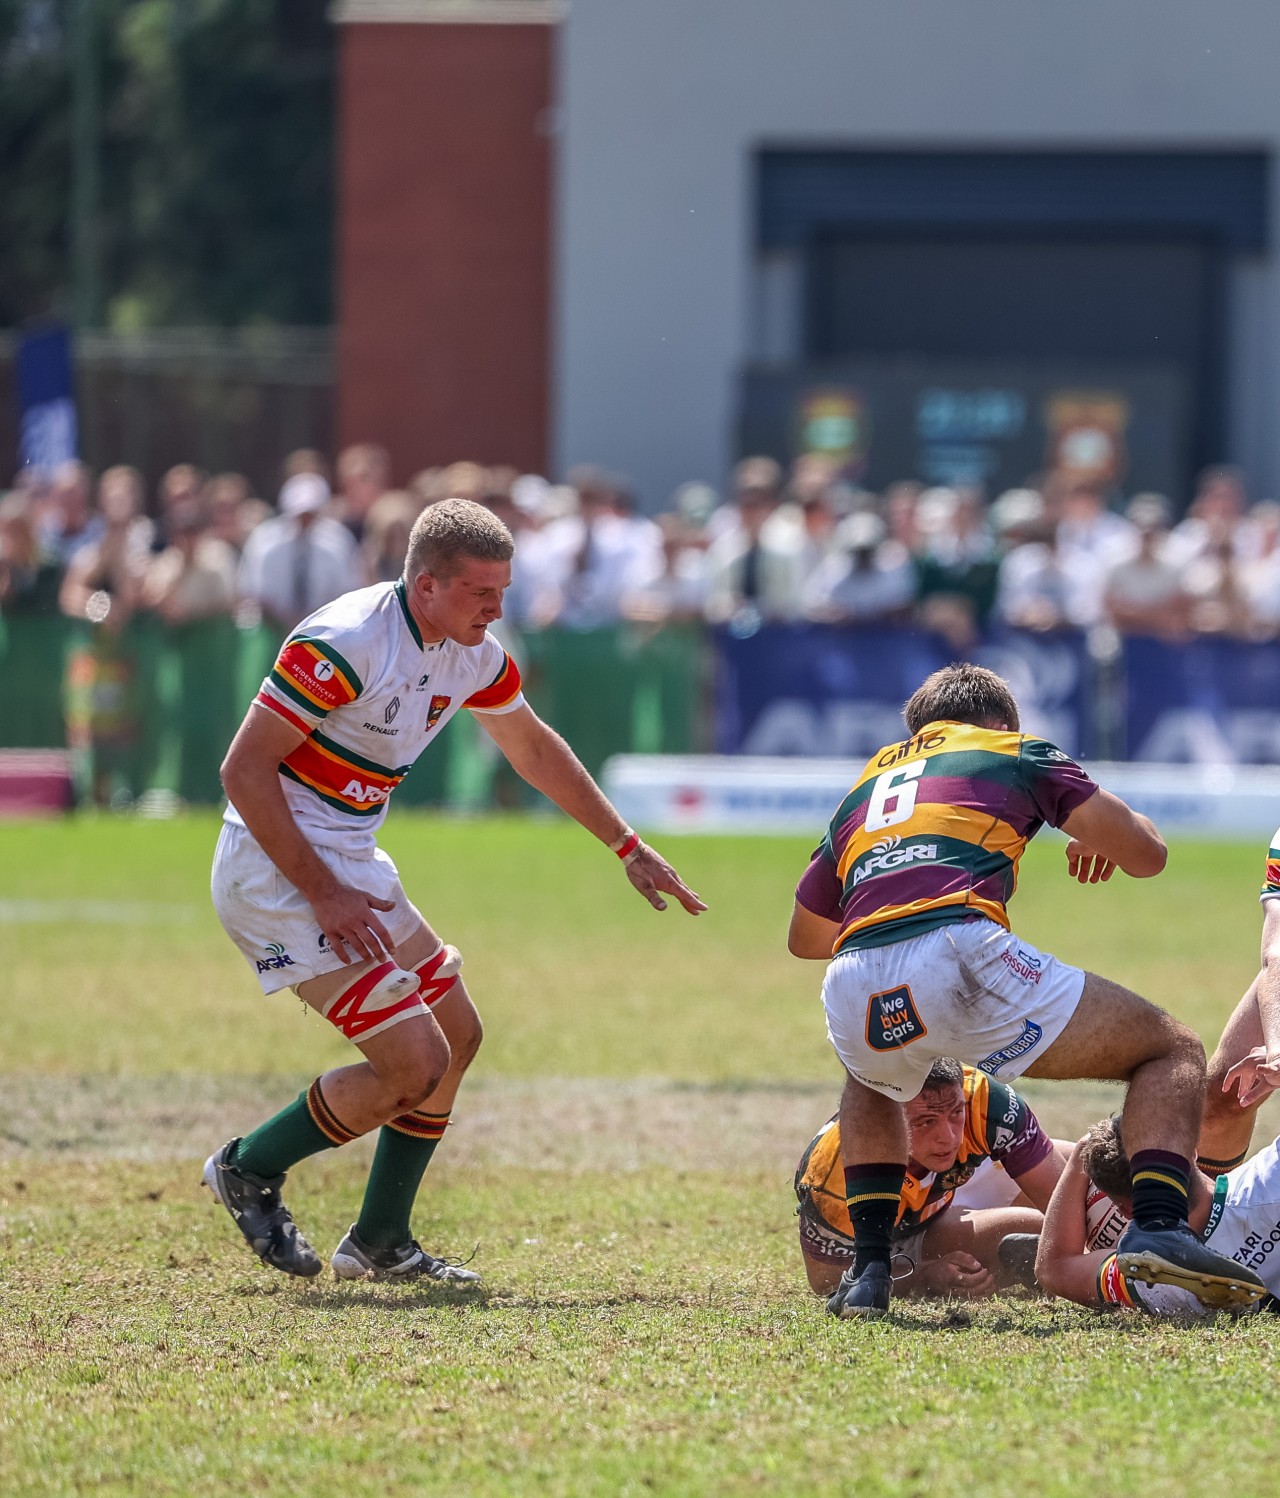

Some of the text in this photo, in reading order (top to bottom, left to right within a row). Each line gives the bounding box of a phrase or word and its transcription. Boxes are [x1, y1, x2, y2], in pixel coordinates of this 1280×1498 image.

[362, 722, 400, 736] RENAULT
[864, 758, 928, 834] 6
[852, 843, 938, 887] AFGRI
[880, 1008, 909, 1029] buy
[881, 996, 905, 1014] we
[882, 1020, 915, 1042] cars
[980, 1027, 1039, 1073] BLUE RIBBON
[1203, 1202, 1222, 1238] GUTS
[1232, 1231, 1263, 1264] FARI
